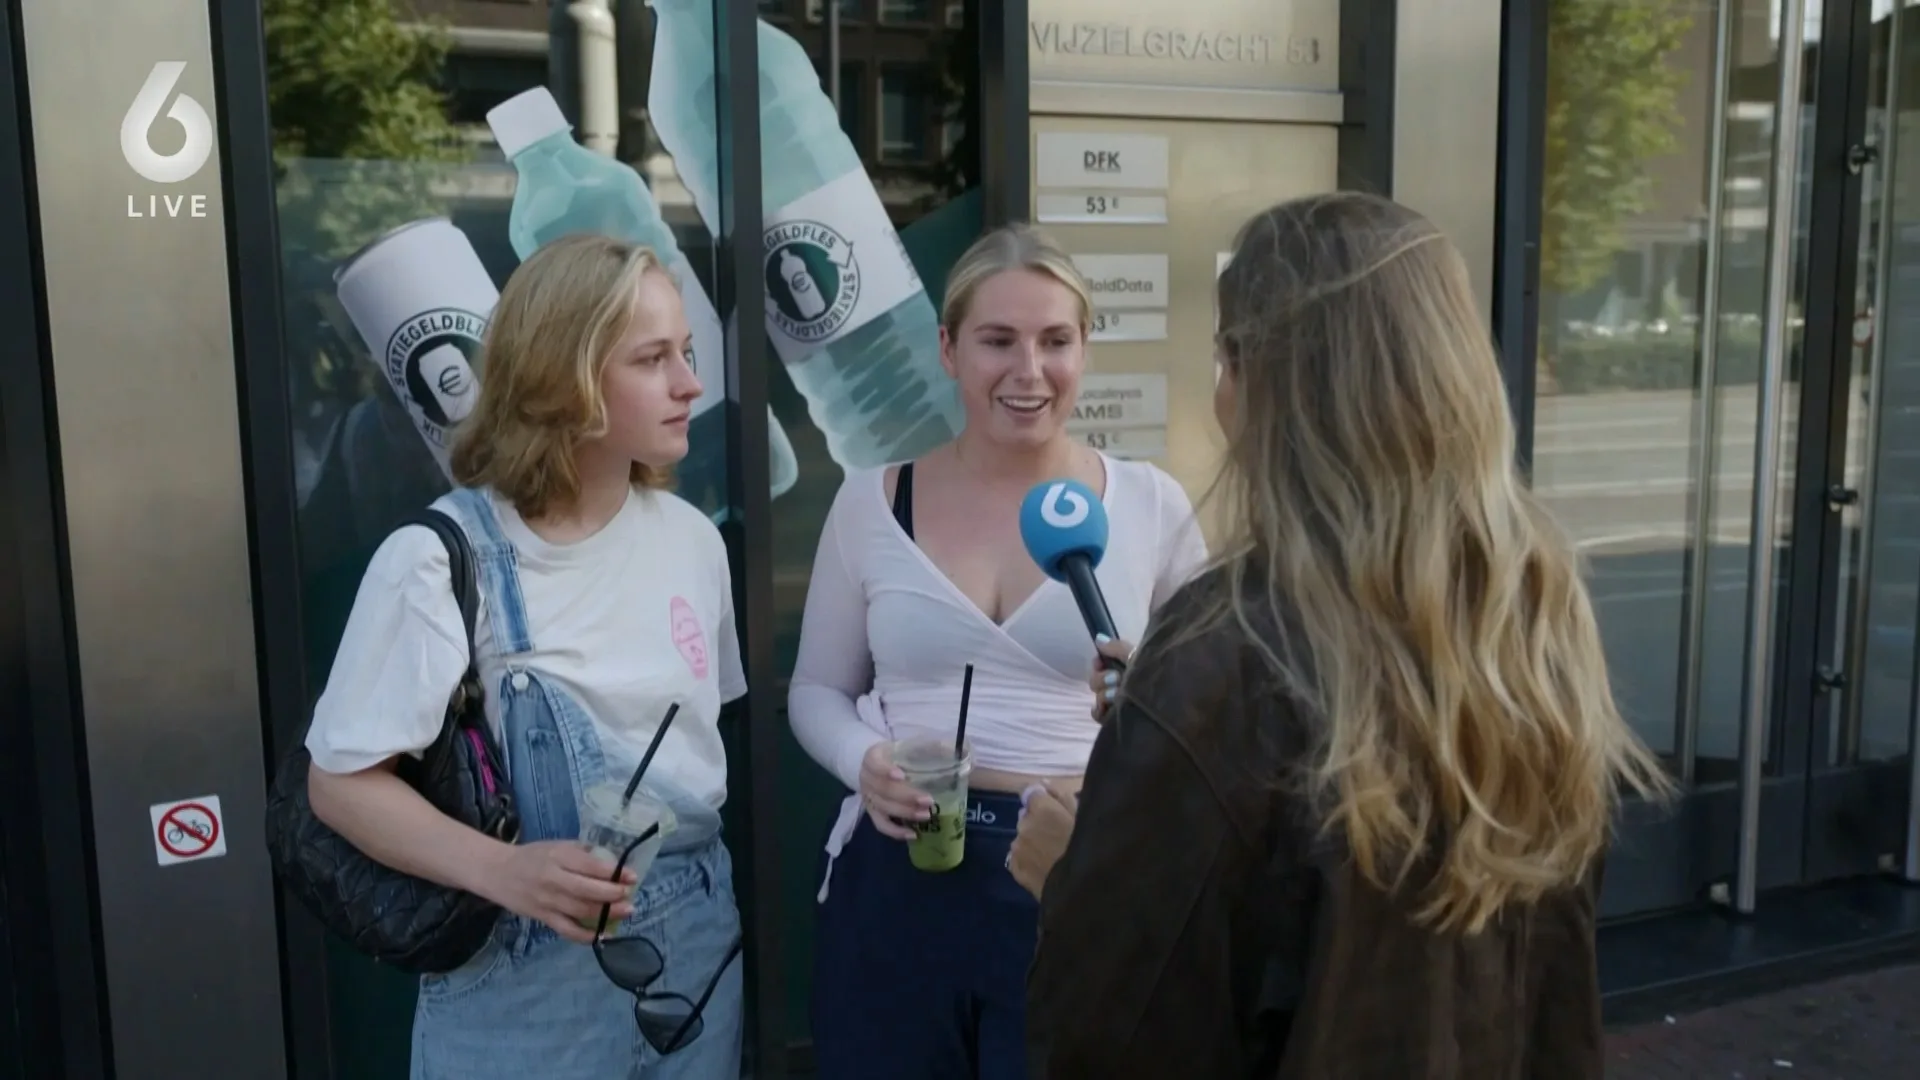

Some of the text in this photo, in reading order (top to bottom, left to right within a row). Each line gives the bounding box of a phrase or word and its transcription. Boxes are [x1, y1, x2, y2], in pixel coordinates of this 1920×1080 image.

[1031, 21, 1320, 64] VIJZELGRACHT 53
[1084, 150, 1121, 171] DFK
[1086, 196, 1106, 214] 53
[765, 225, 837, 251] GELDFLES
[391, 314, 484, 388] STATIEGELDBLI
[1087, 433, 1106, 450] 53
[1041, 483, 1089, 528] 6
[966, 801, 996, 824] alo
